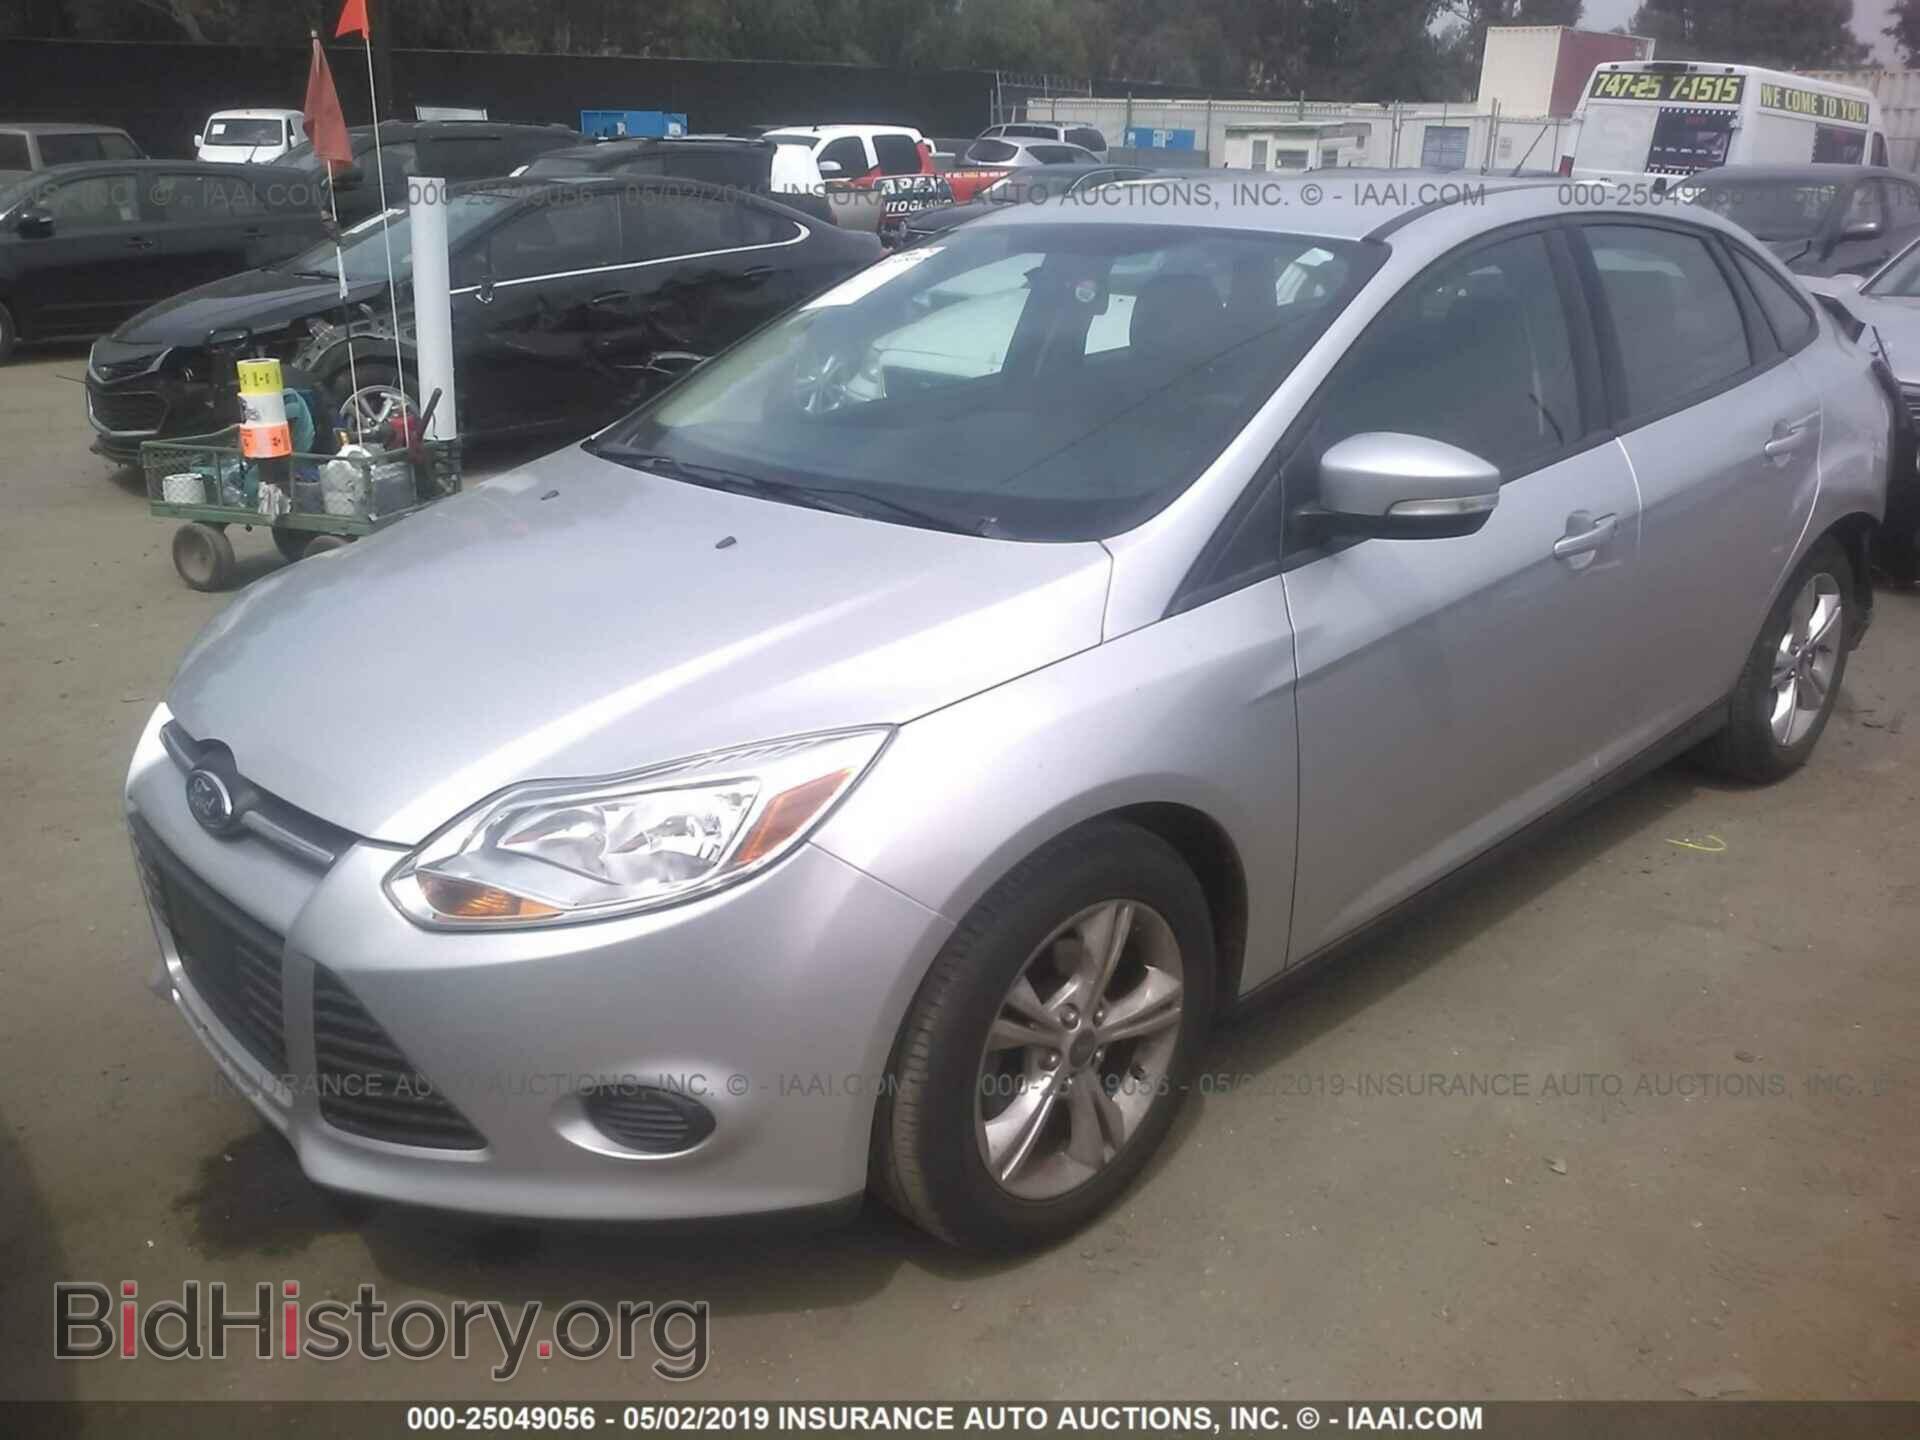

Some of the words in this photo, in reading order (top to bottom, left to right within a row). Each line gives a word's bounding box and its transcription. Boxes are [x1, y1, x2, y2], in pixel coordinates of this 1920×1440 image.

[1668, 76, 1741, 102] 7-1515
[1761, 83, 1781, 108] WE
[1785, 89, 1819, 114] COME
[1822, 96, 1837, 118] TO
[881, 177, 942, 195] APEX
